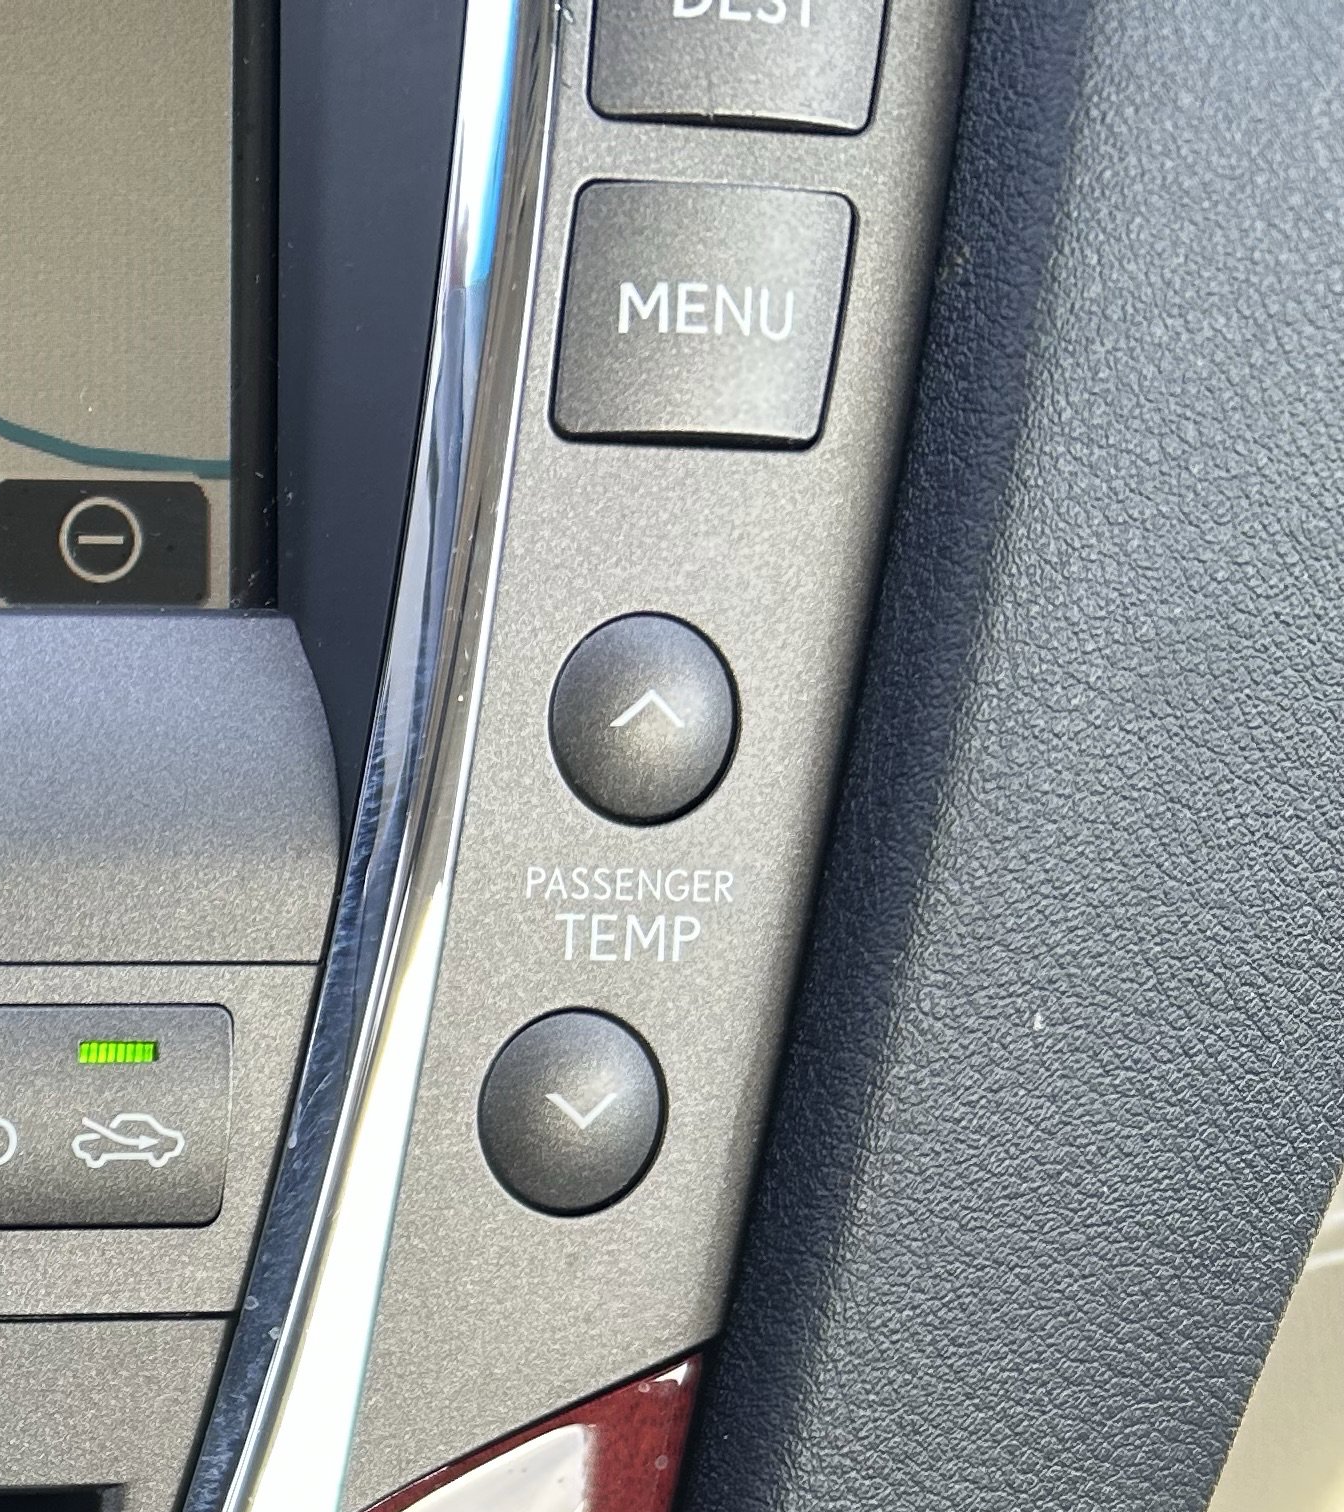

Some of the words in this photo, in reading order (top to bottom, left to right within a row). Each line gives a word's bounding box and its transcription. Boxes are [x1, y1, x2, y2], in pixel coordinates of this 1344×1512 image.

[617, 281, 796, 337] MENU
[525, 866, 734, 903] PASSENGER
[554, 912, 702, 963] TEMP
